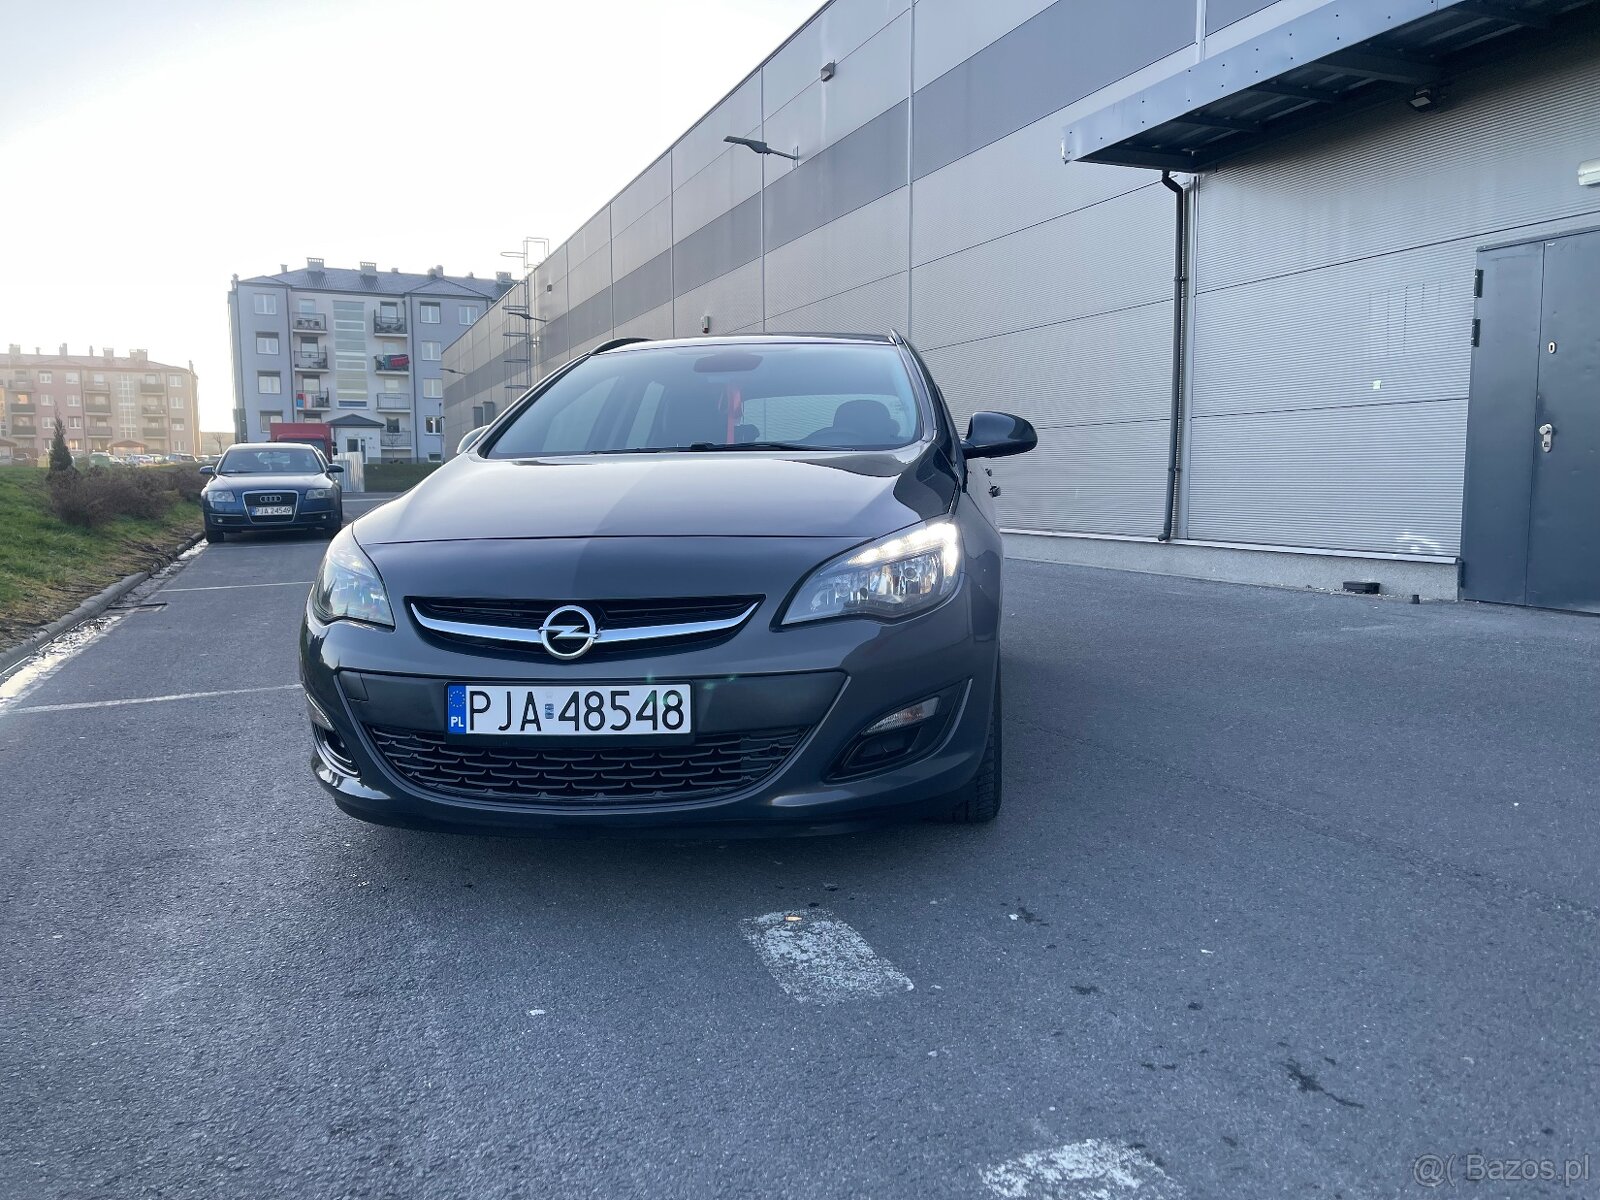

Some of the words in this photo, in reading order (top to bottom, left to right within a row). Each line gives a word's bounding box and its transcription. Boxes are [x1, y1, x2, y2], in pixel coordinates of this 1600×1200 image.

[450, 716, 464, 727] PL
[469, 690, 542, 732] PJA
[558, 689, 684, 732] 48548
